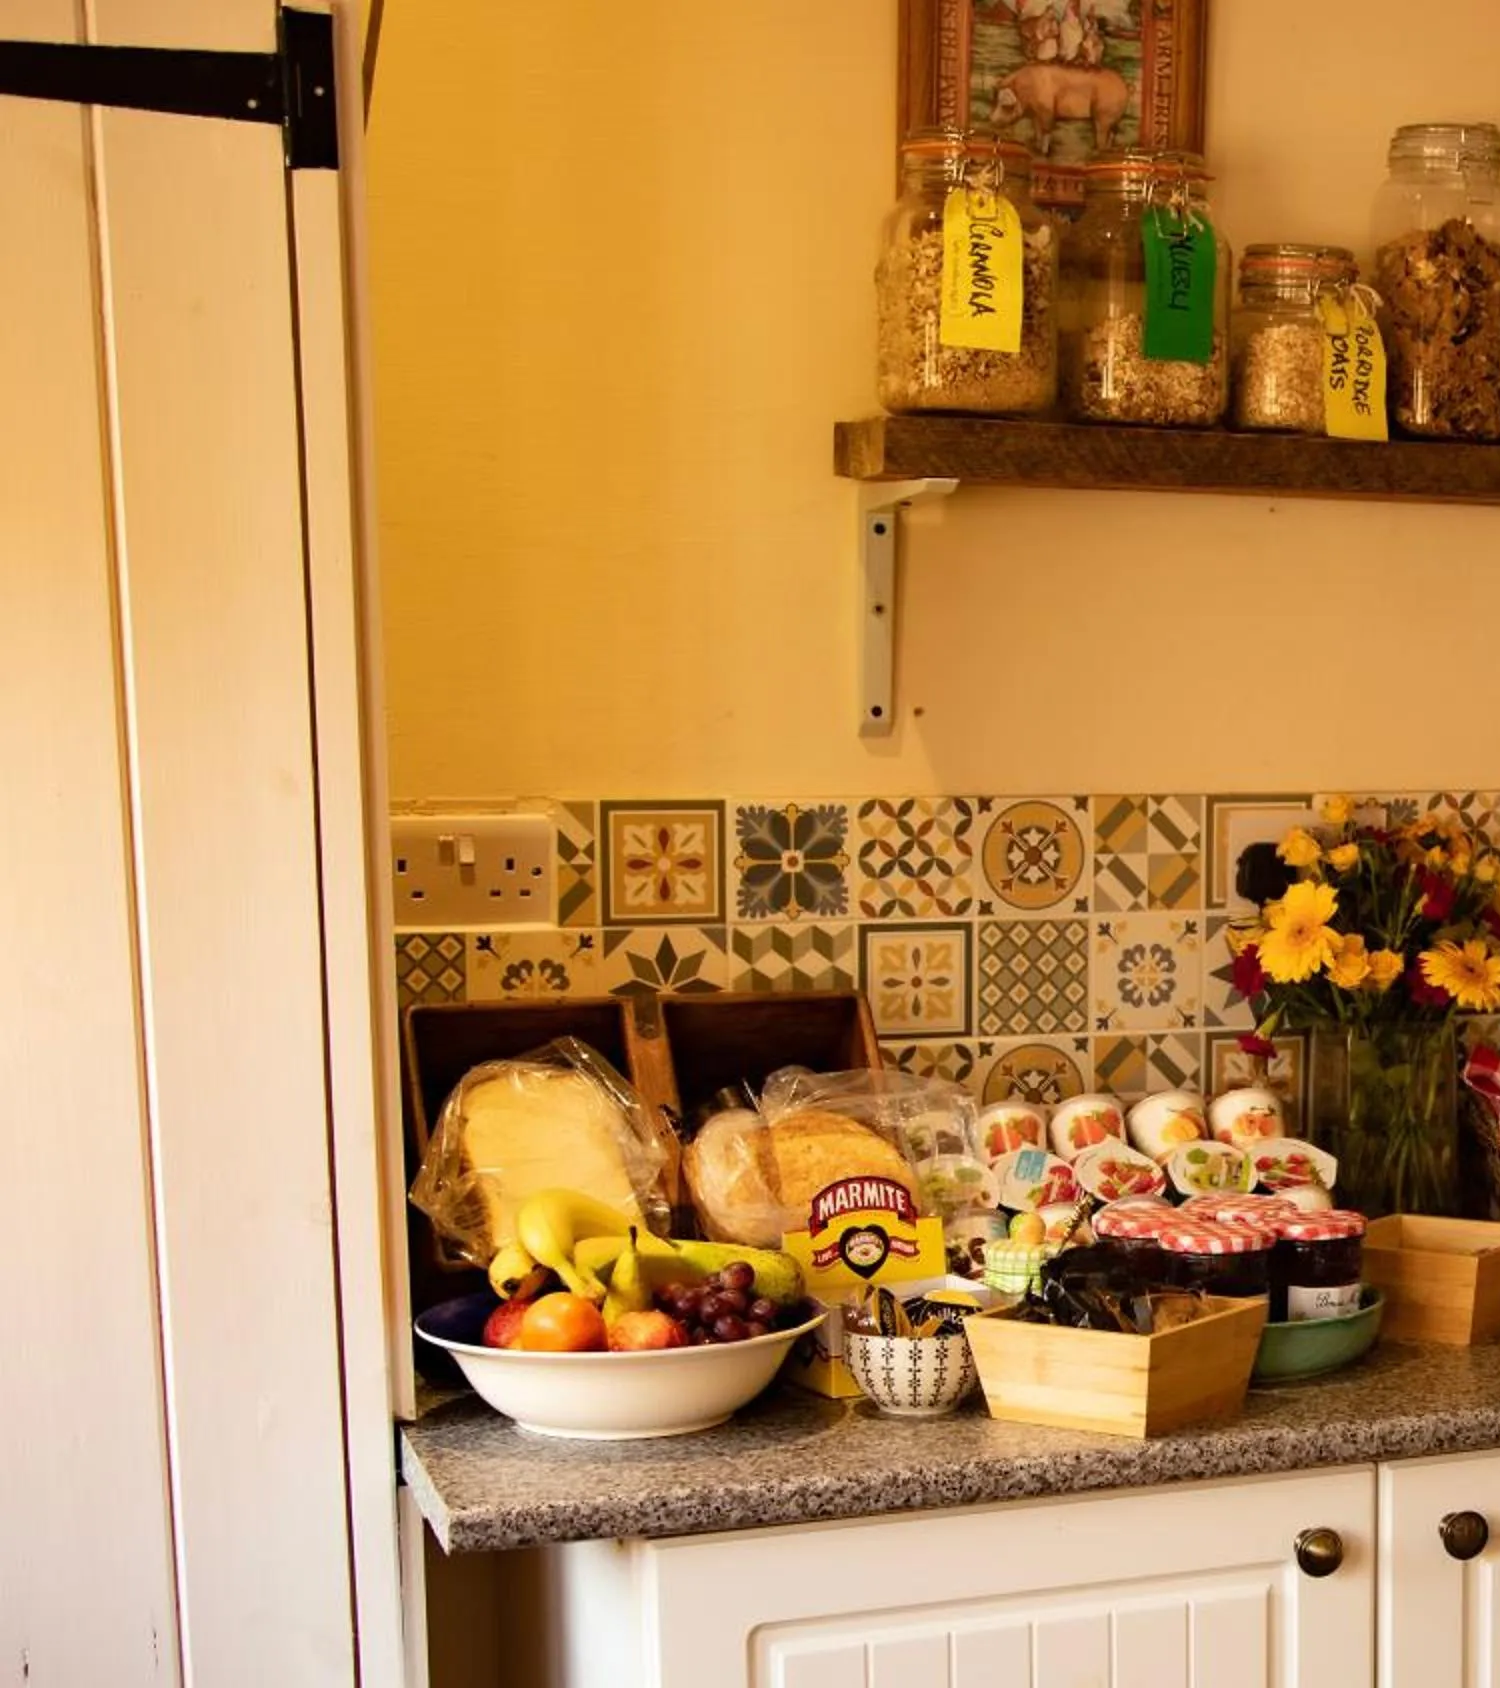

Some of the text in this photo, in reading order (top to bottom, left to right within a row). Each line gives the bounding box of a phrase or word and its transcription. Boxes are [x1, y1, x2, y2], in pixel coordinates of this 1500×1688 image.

[1330, 336, 1351, 391] OATS
[1352, 324, 1375, 417] PORRIDGE
[818, 1181, 906, 1221] MARMITE
